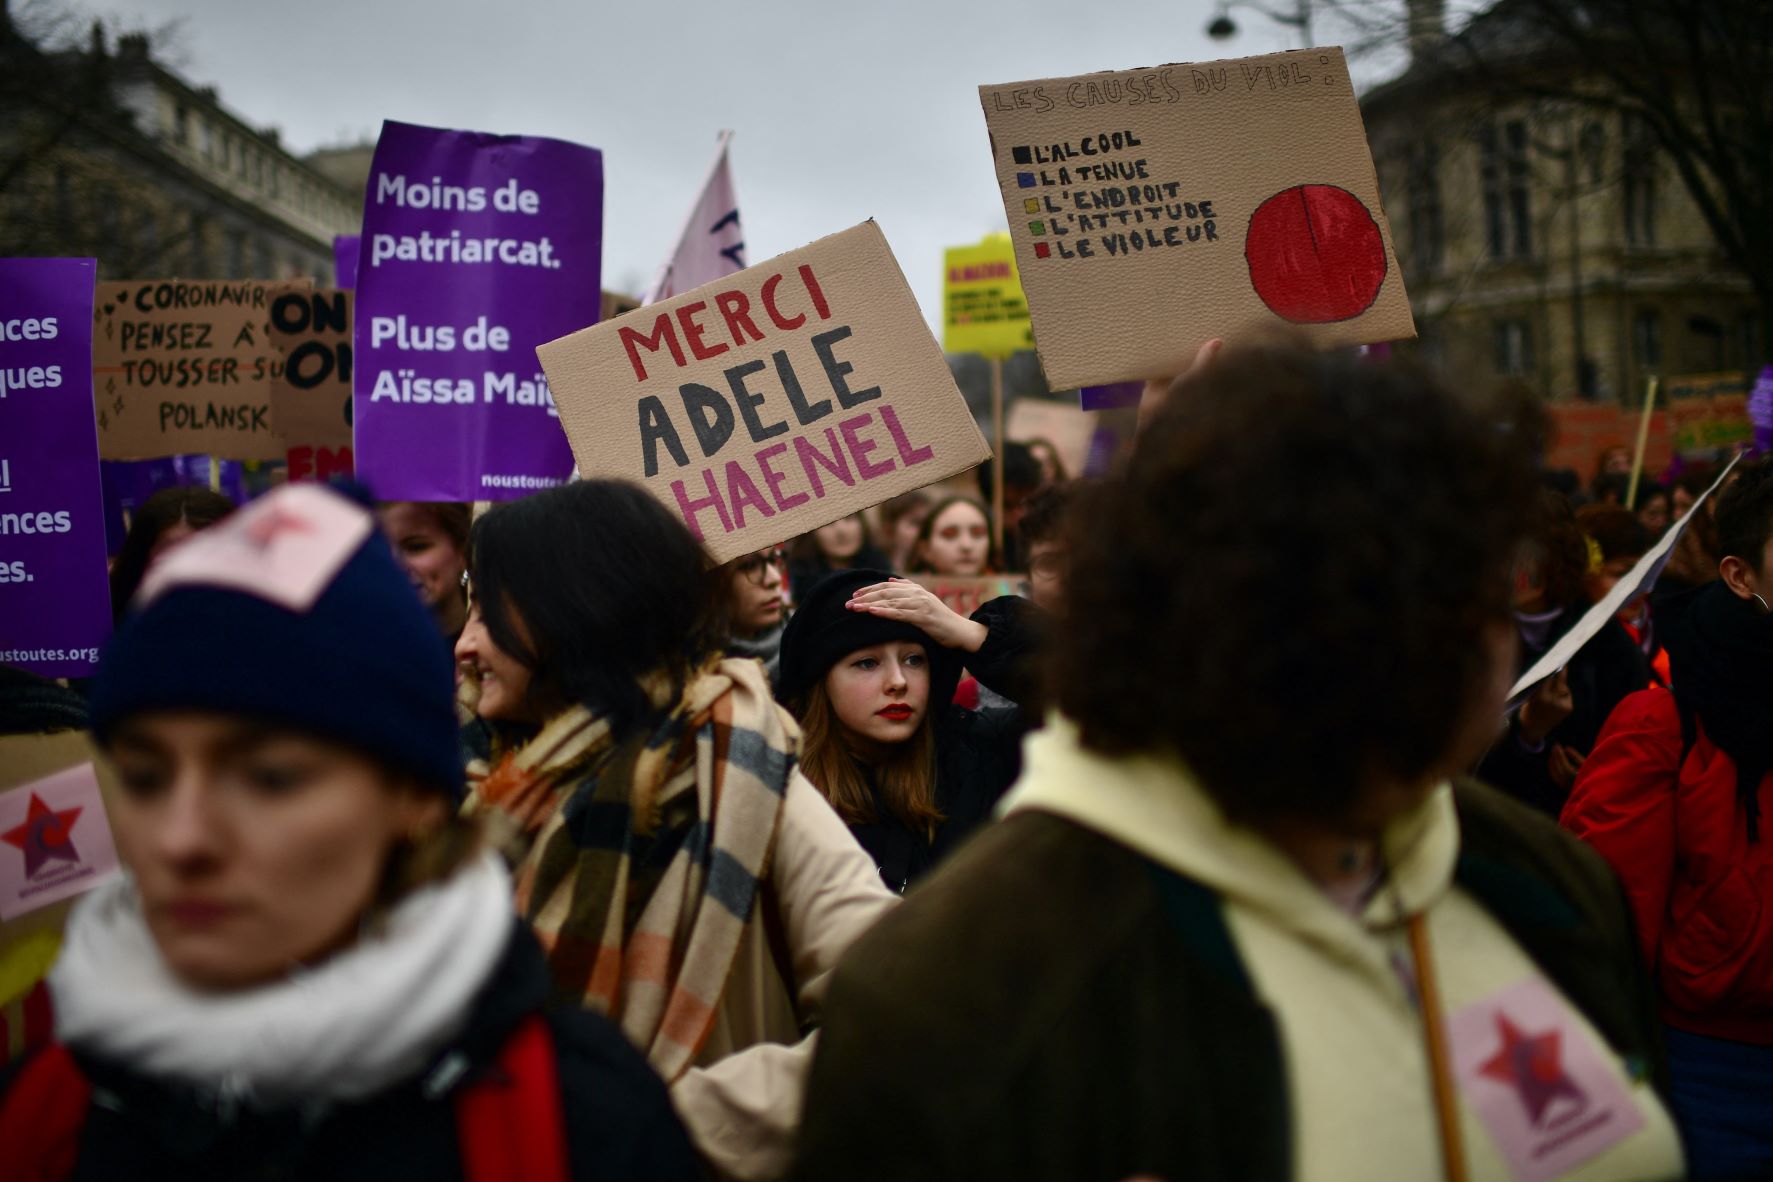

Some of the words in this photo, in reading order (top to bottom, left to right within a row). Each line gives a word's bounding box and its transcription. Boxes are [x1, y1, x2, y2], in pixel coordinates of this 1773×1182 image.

[993, 86, 1055, 113] LES
[1066, 68, 1180, 109] CAUSES
[1191, 67, 1227, 95] DU
[1240, 62, 1312, 91] VIOL
[1035, 130, 1142, 164] L'ALCOOL
[1040, 166, 1073, 186] LA
[1075, 159, 1150, 181] TENUE
[376, 172, 487, 213] Moins
[492, 178, 540, 215] de
[1043, 181, 1181, 213] L'ENDROIT
[1050, 200, 1218, 236] L'ATTITUDE
[371, 229, 562, 268] patriarcat.
[1057, 239, 1095, 260] LE
[1101, 219, 1220, 257] VIOLEUR
[0, 316, 59, 342] ces
[271, 291, 347, 335] ON
[617, 263, 832, 383] MERCI
[120, 320, 214, 353] PENSEZ
[370, 315, 456, 352] Plus
[462, 315, 511, 352] de
[120, 356, 240, 389] TOUSSER
[370, 369, 476, 405] Aïssa
[159, 399, 270, 433] POLANSK
[637, 324, 882, 479] ADELE
[669, 404, 935, 543] HAENEL
[0, 510, 72, 535] nces
